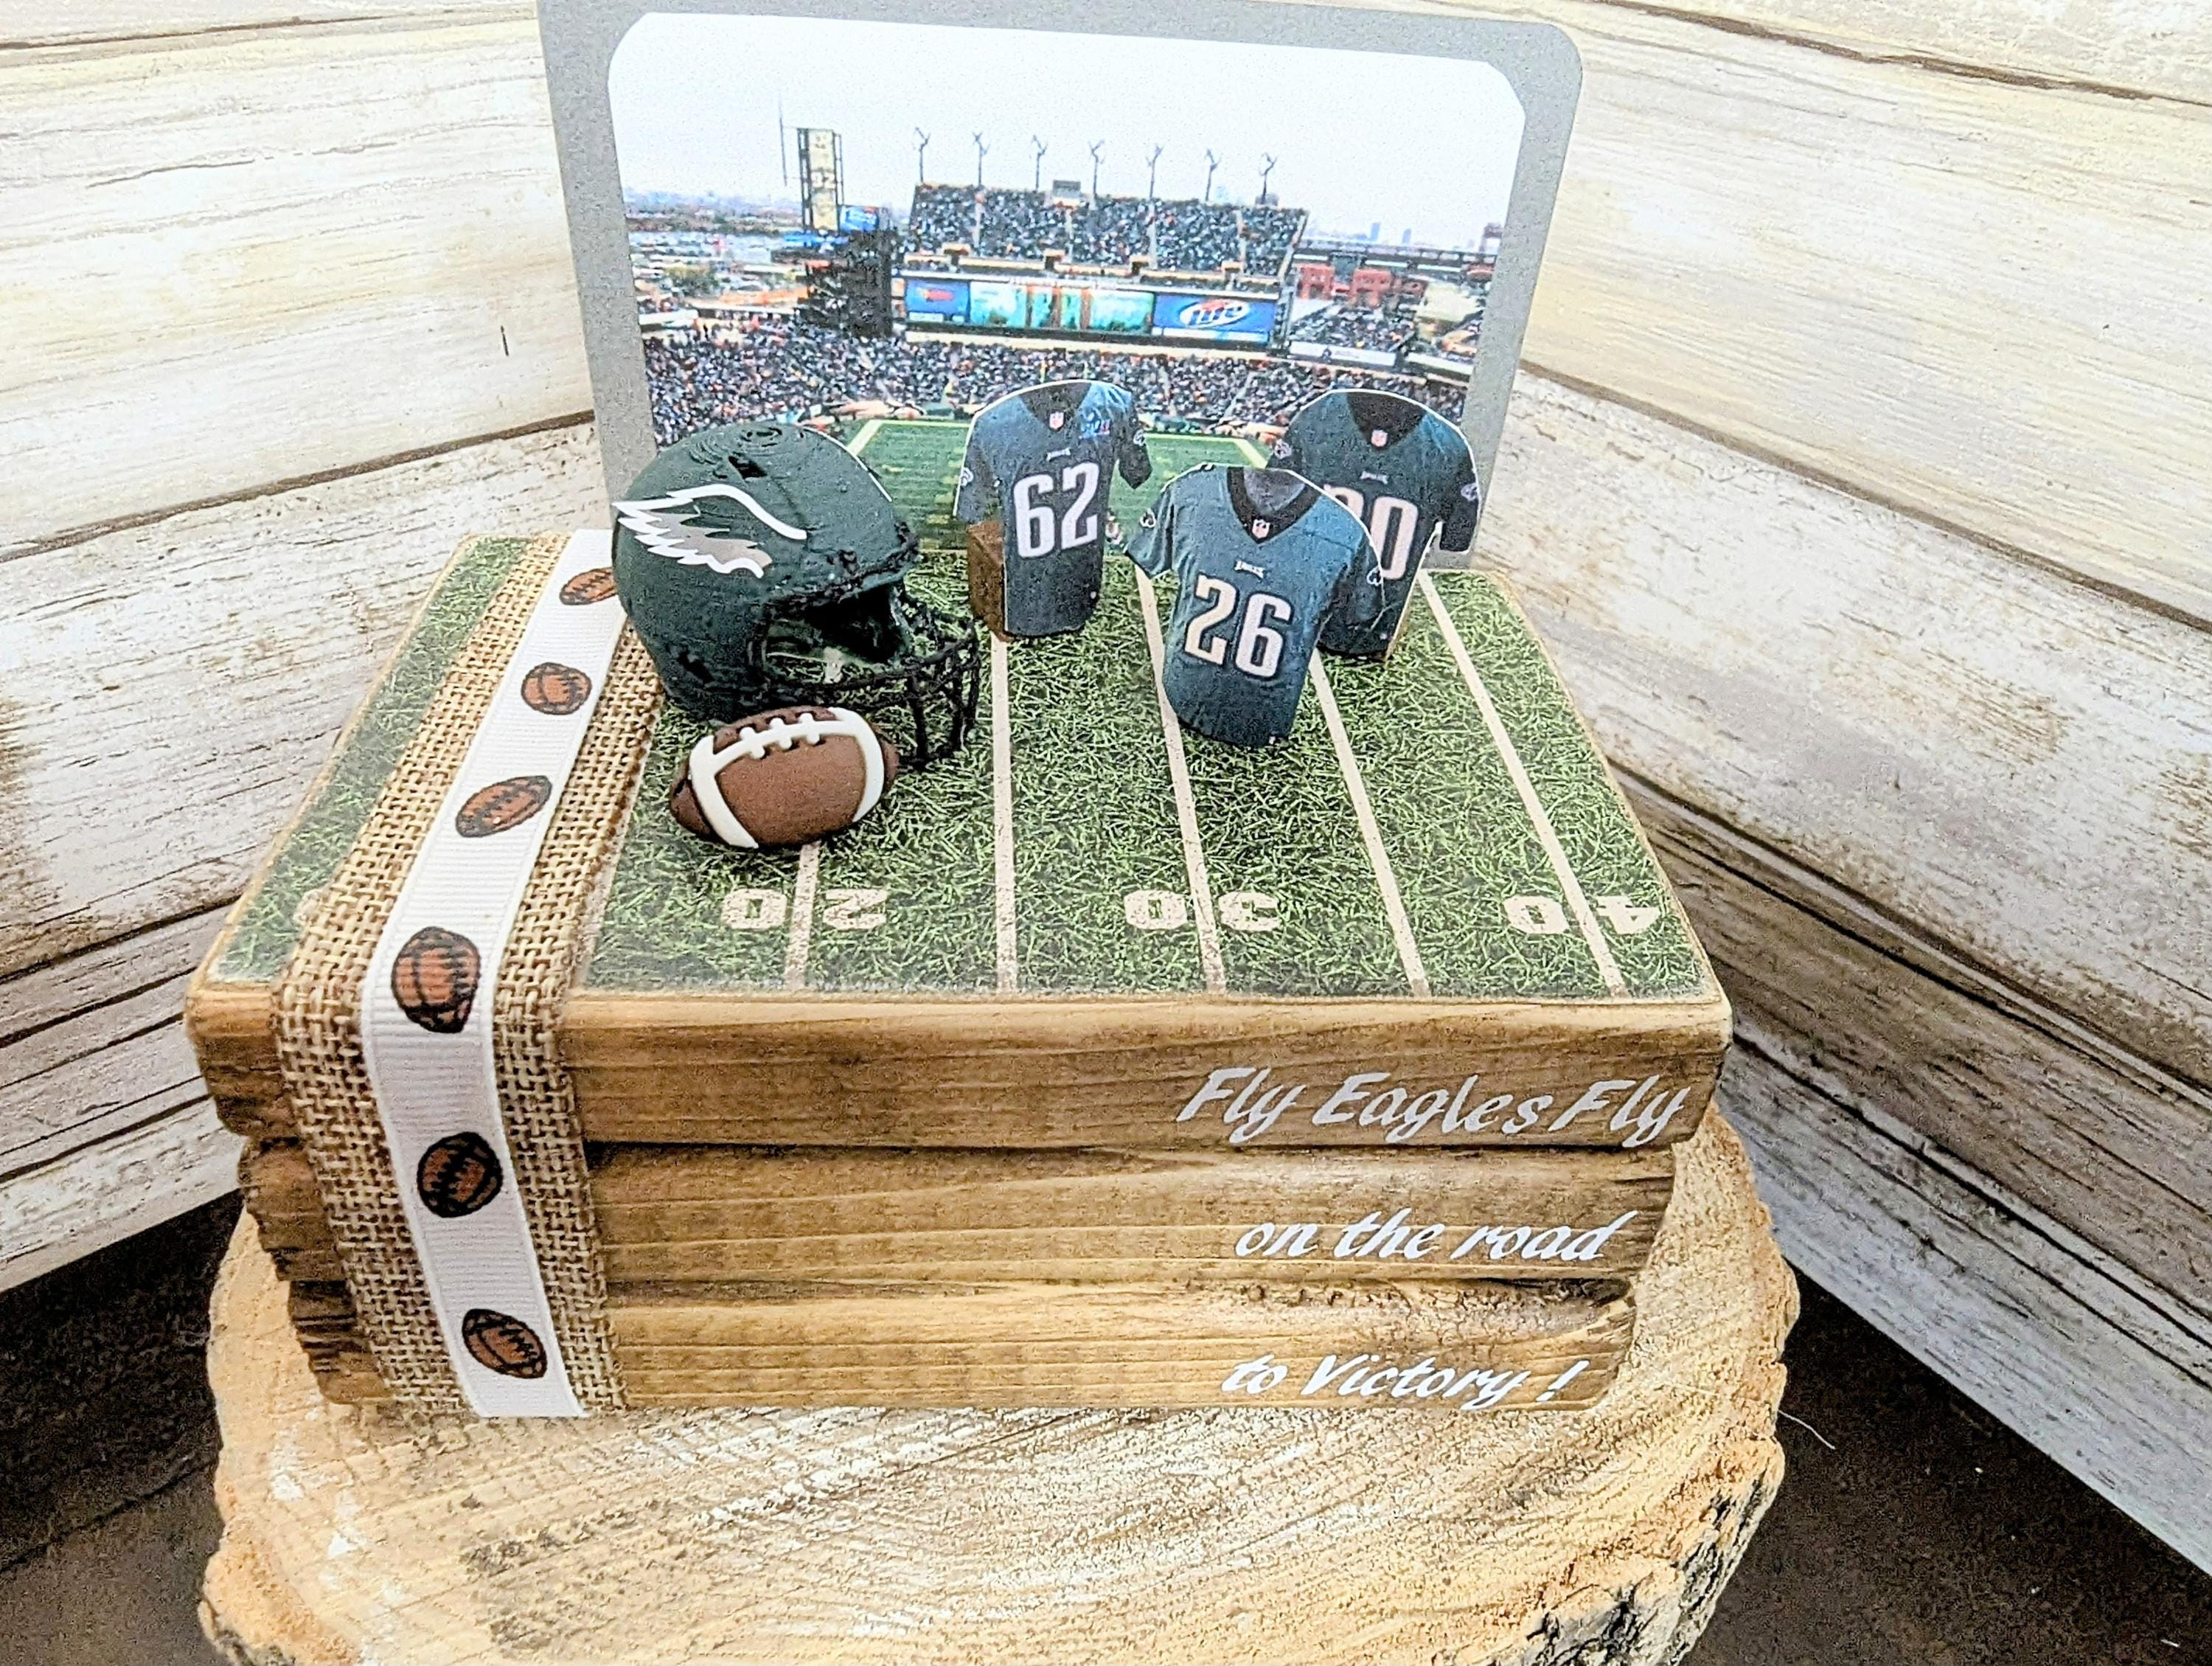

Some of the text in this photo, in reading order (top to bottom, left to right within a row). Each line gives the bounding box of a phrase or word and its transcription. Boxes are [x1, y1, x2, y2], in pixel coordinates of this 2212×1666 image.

[1012, 462, 1099, 559] 62
[1184, 573, 1293, 678] 26
[1177, 1066, 1691, 1148] Fly Eagles Fly
[1236, 1207, 1638, 1262] on the road
[1221, 1353, 1590, 1411] to Victory !
